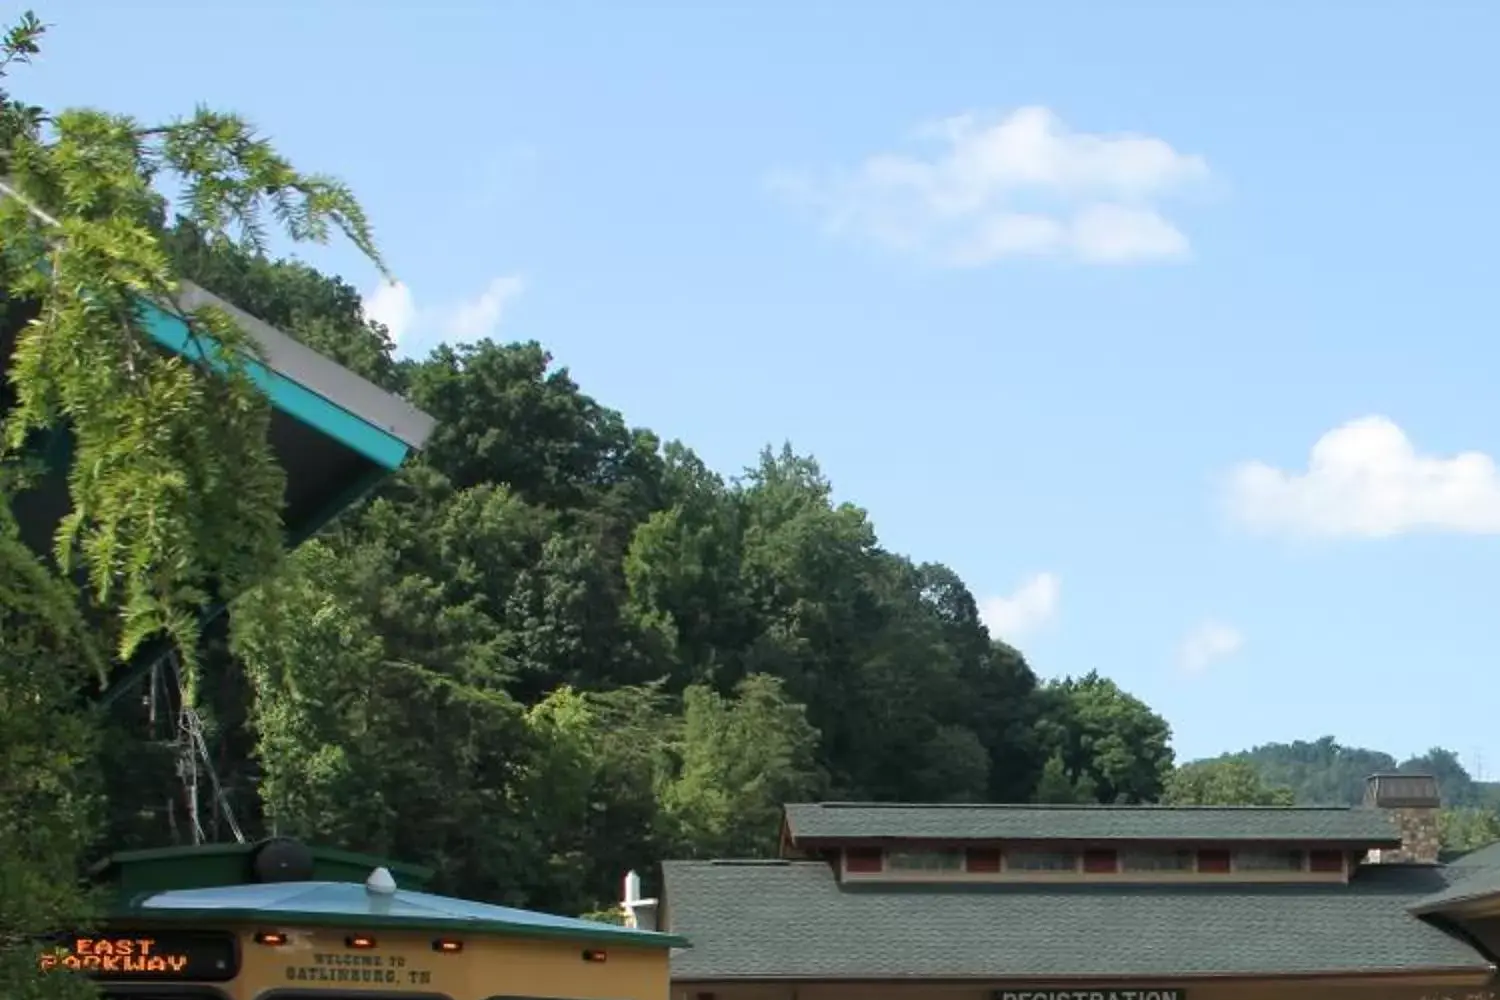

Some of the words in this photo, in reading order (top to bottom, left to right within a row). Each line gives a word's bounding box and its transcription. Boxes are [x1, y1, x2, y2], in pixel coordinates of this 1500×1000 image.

[77, 938, 155, 955] EAST
[40, 954, 187, 971] PARKWAY
[314, 954, 383, 966] WELCOME
[390, 956, 405, 967] TO
[409, 971, 431, 984] TN
